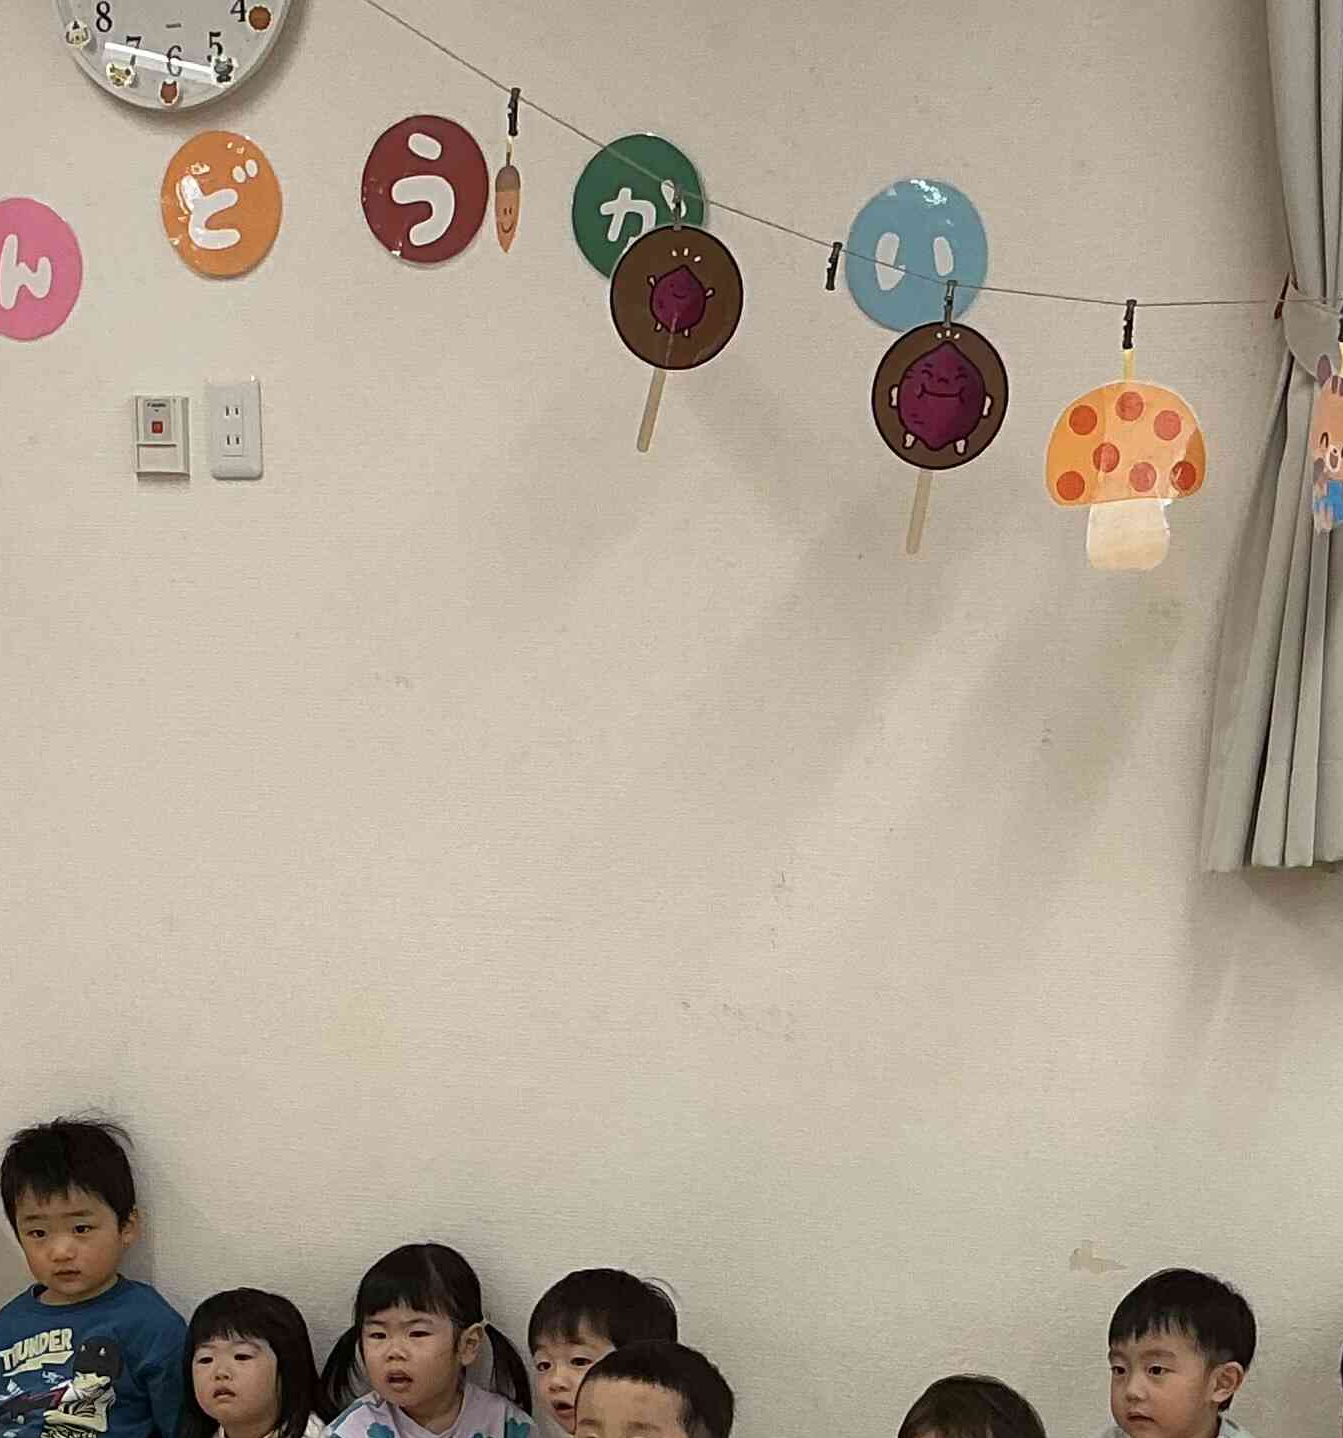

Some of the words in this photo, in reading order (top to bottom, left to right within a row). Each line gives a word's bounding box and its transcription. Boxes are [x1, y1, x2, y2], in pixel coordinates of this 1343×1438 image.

[95, 0, 113, 32] 8
[230, 0, 247, 22] 4
[125, 35, 142, 66] 7
[166, 45, 183, 77] 6
[207, 31, 224, 62] 5
